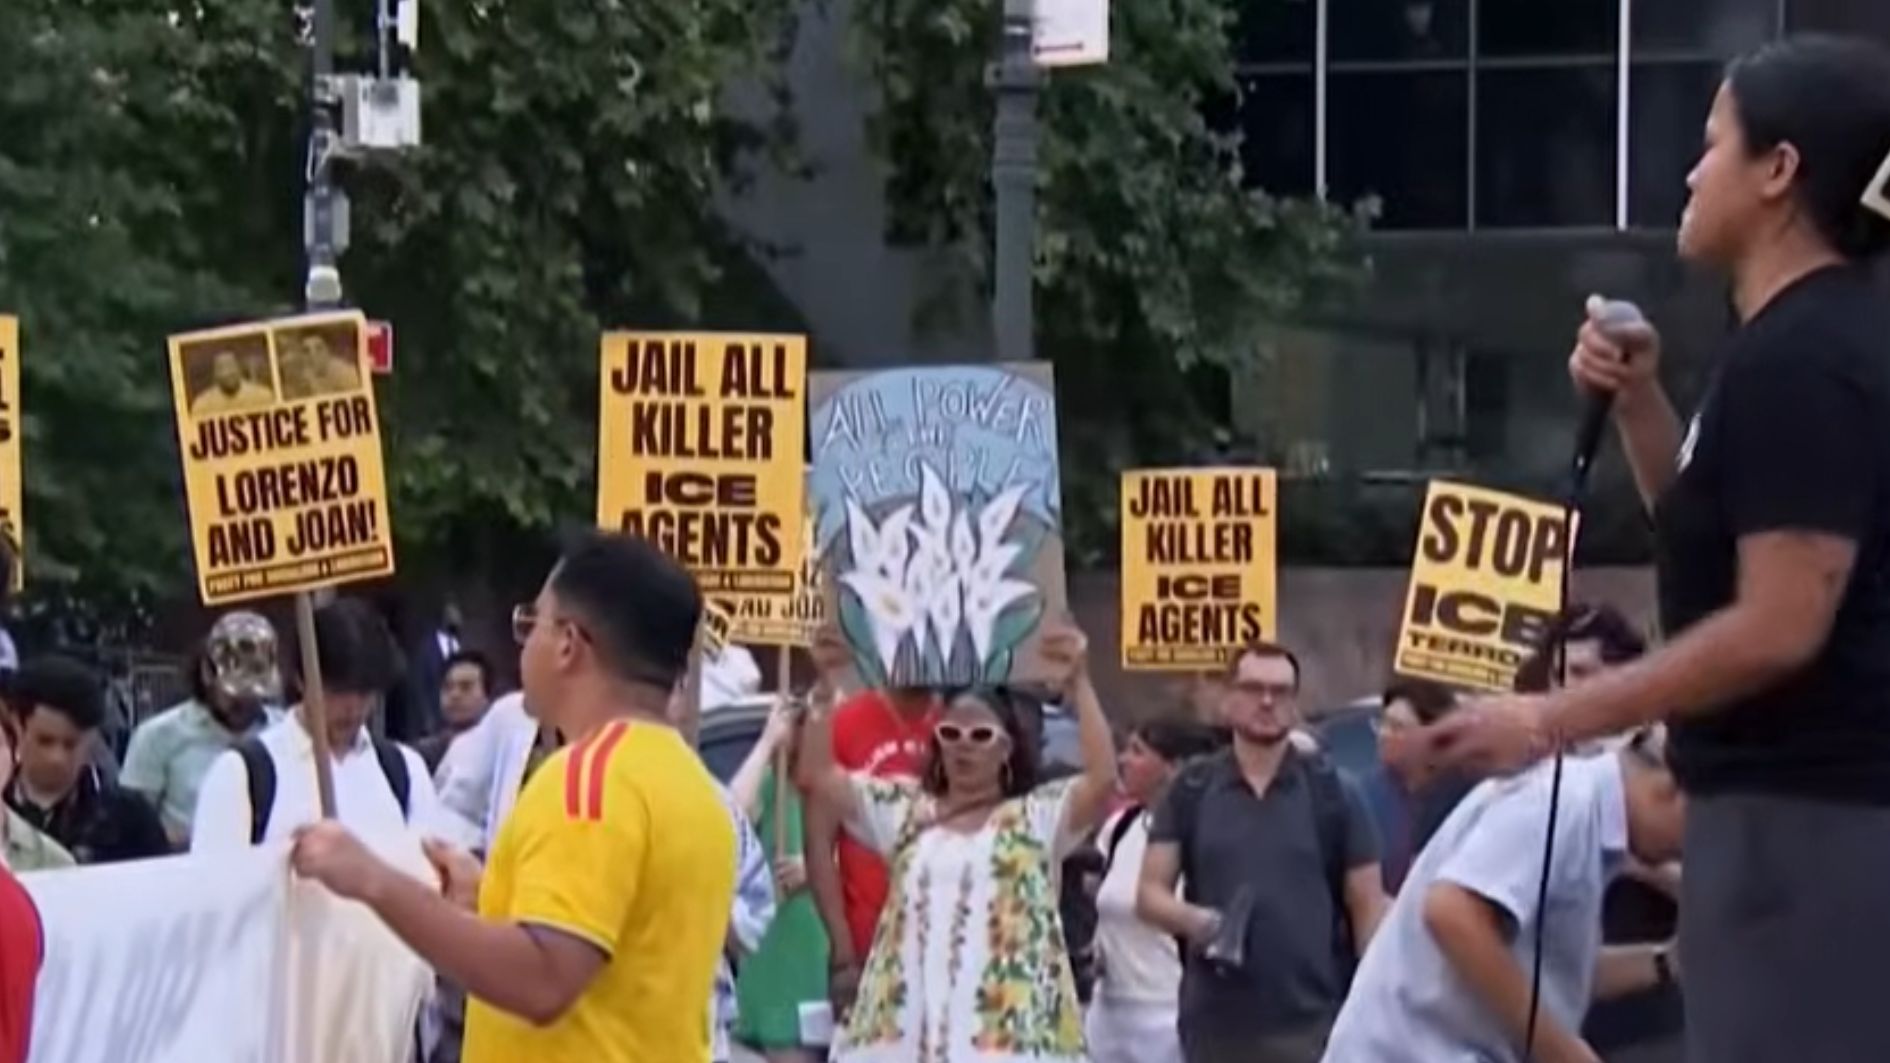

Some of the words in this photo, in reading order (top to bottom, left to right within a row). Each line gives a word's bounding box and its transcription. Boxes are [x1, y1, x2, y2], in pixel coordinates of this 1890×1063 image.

[611, 340, 705, 395] JAIL
[720, 343, 796, 399] ALL
[190, 405, 311, 461] JUSTICE
[317, 395, 372, 441] FOR
[632, 402, 773, 460] KILLER
[911, 375, 1048, 447] POWER
[215, 453, 359, 517] LORENZO
[645, 471, 757, 508] ICE
[1129, 475, 1200, 518] JAIL
[1211, 475, 1269, 518] ALL
[207, 517, 276, 569] AND
[285, 498, 379, 556] JOAN!
[1145, 522, 1254, 565] KILLER
[1422, 493, 1565, 584] STOP
[1157, 574, 1241, 600] ICE
[1410, 584, 1551, 644] ICE
[1138, 602, 1262, 645] AGENTS
